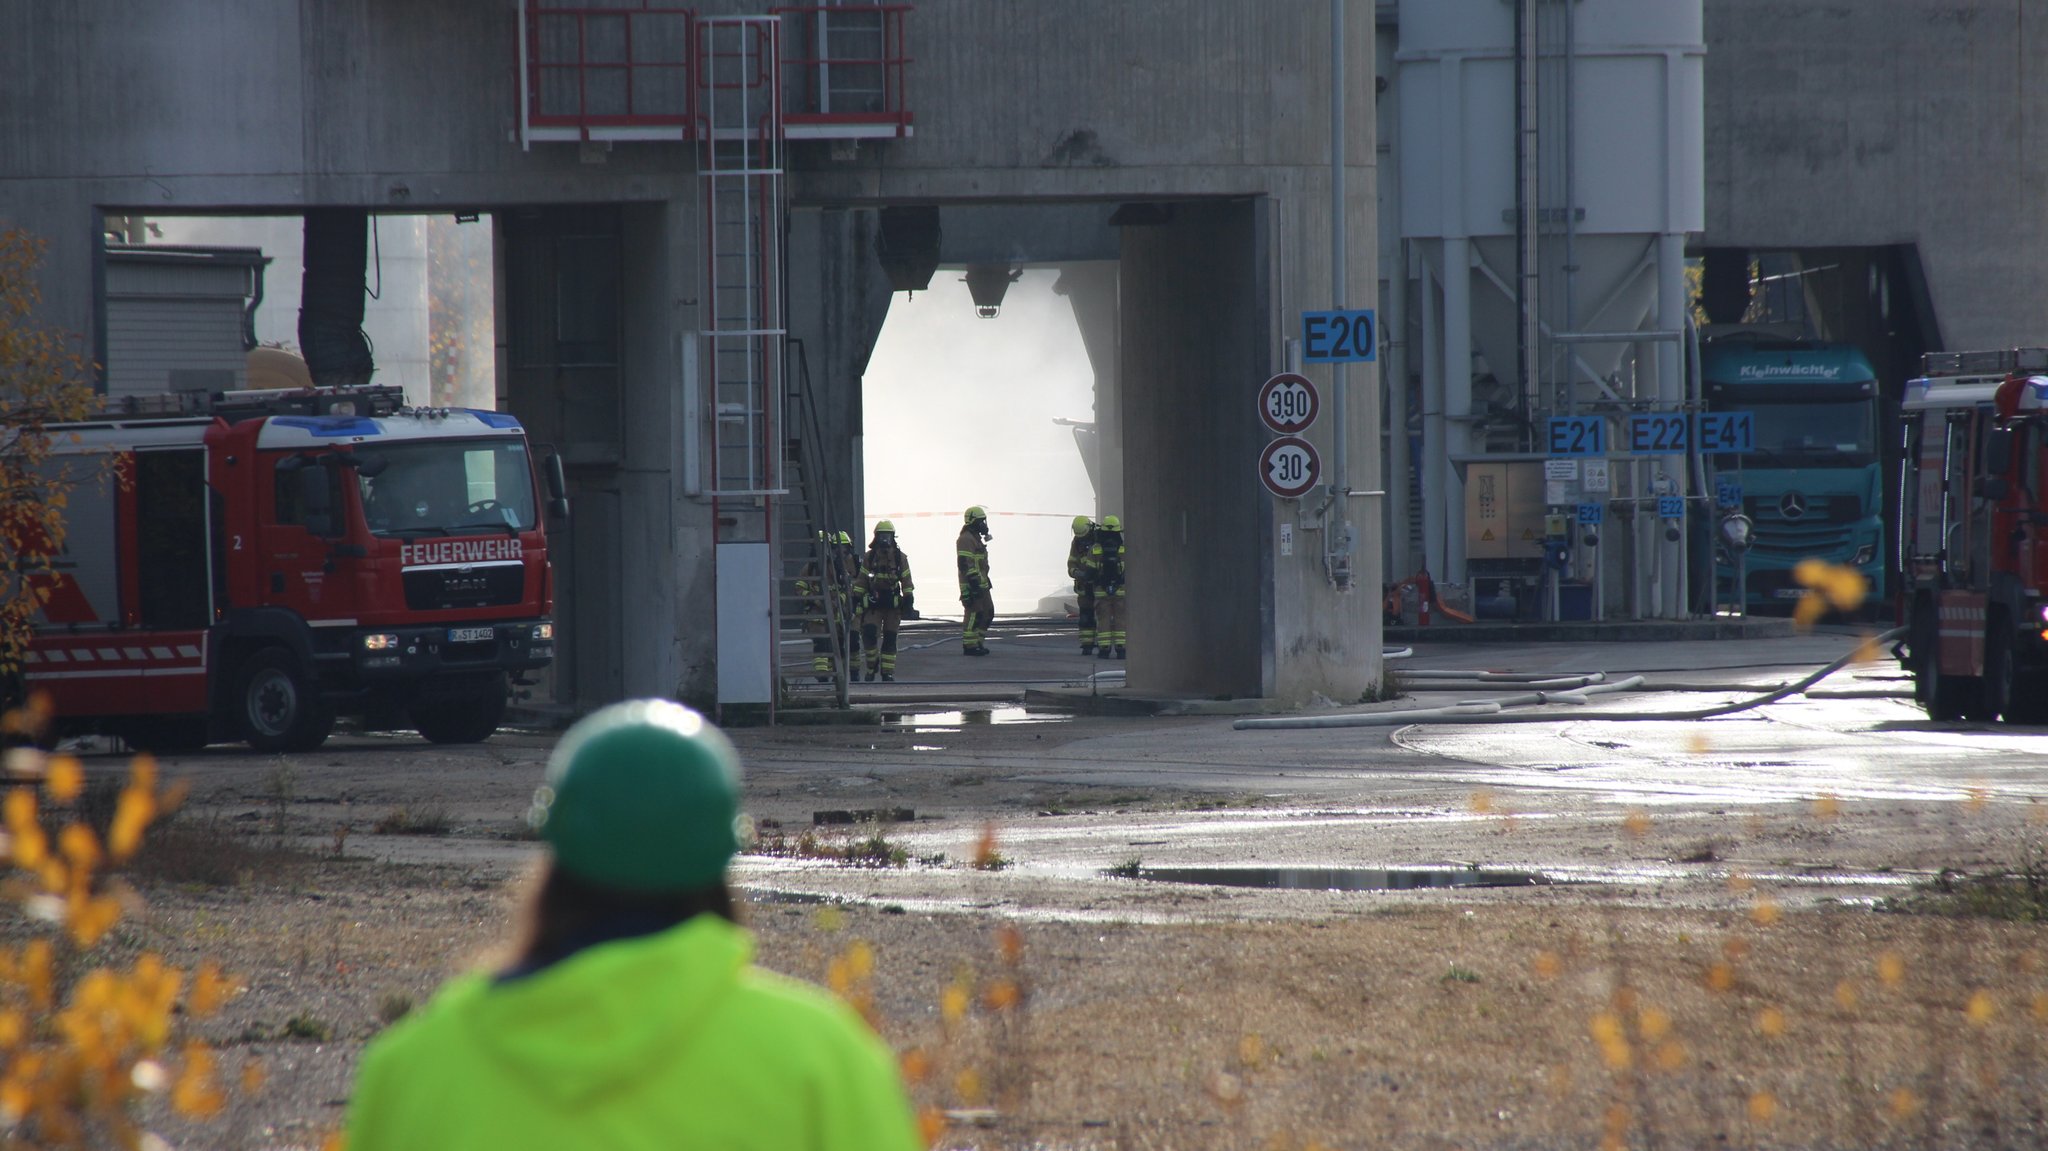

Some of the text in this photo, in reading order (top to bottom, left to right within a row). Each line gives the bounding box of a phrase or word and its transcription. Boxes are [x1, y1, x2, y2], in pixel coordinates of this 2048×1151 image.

[1304, 315, 1372, 358] E20
[1740, 363, 1840, 378] Kleinwächter
[1550, 420, 1601, 453] E21
[1632, 418, 1685, 451] E22
[1700, 415, 1752, 449] E41
[1719, 487, 1741, 503] E41
[1579, 506, 1601, 521] E21
[1660, 500, 1683, 515] E22
[233, 535, 242, 551] 2
[400, 539, 524, 564] FEUERWEHR
